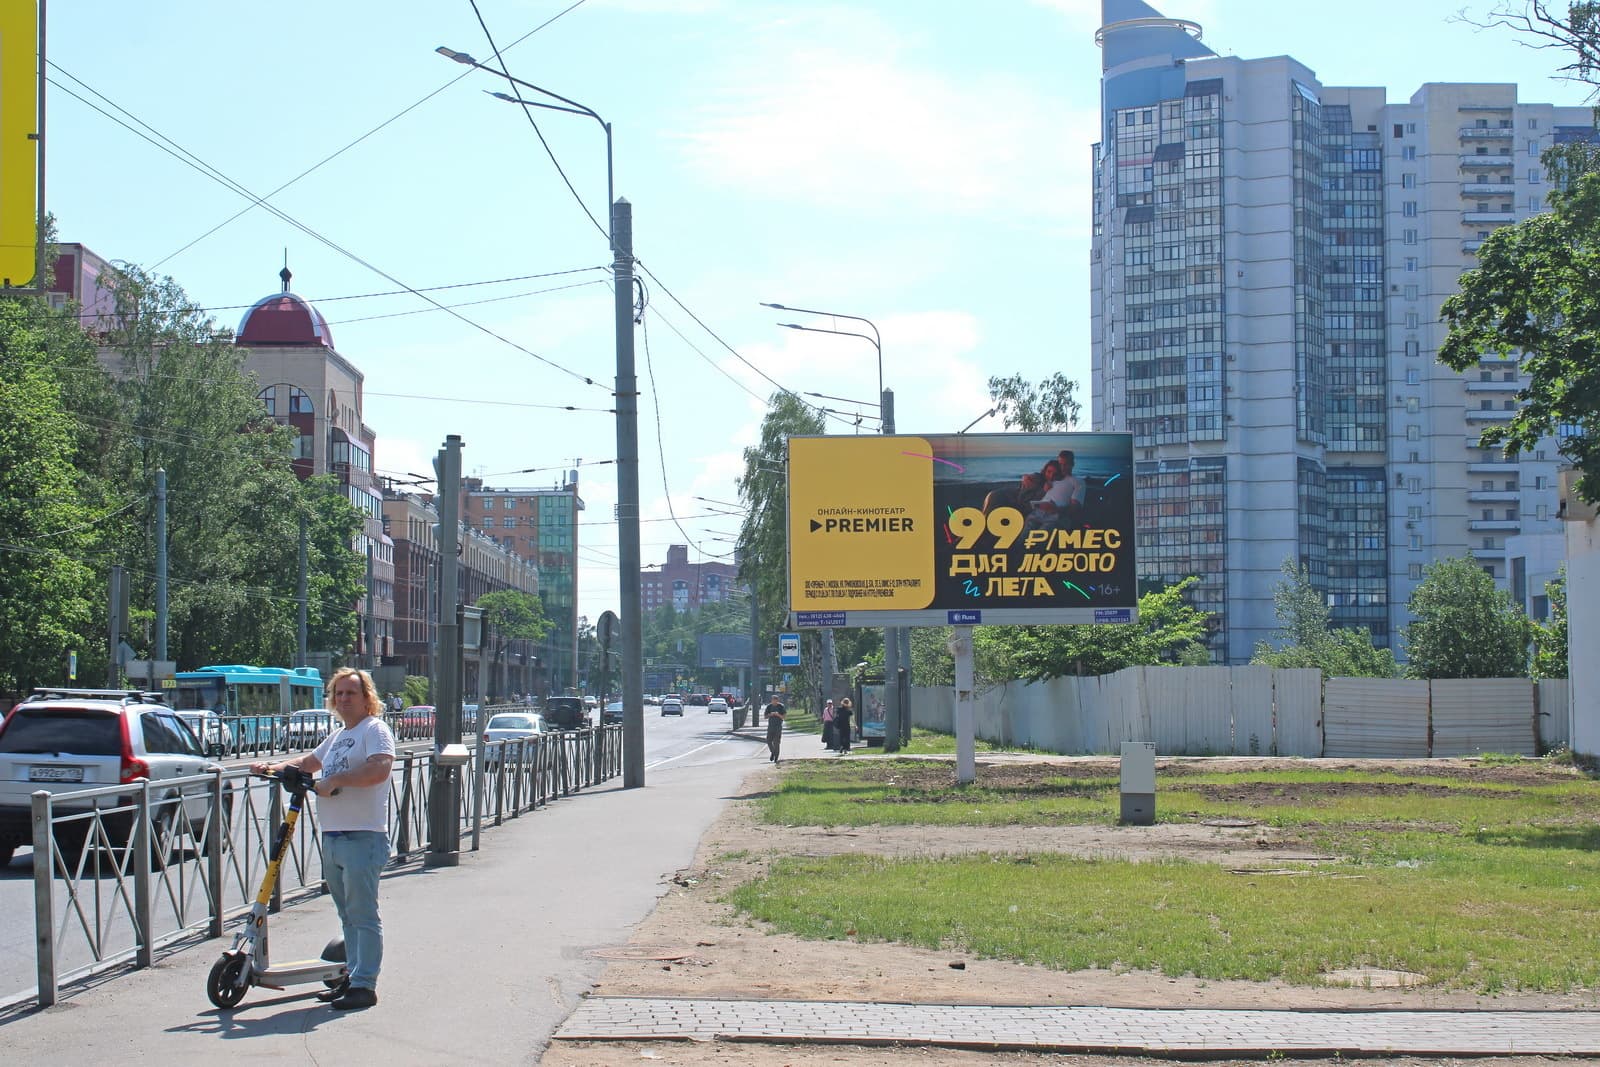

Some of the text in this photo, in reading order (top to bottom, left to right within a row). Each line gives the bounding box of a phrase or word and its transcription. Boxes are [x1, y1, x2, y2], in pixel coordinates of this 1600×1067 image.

[817, 507, 905, 516] ОНЛАЙН-КИНОТЕАТР
[825, 518, 914, 532] PREMIER
[948, 507, 1025, 550] 99
[949, 552, 1116, 577] ДЛЯ ЛЮБОГО
[985, 577, 1055, 597] ЛЕТА
[1098, 584, 1121, 596] 16+
